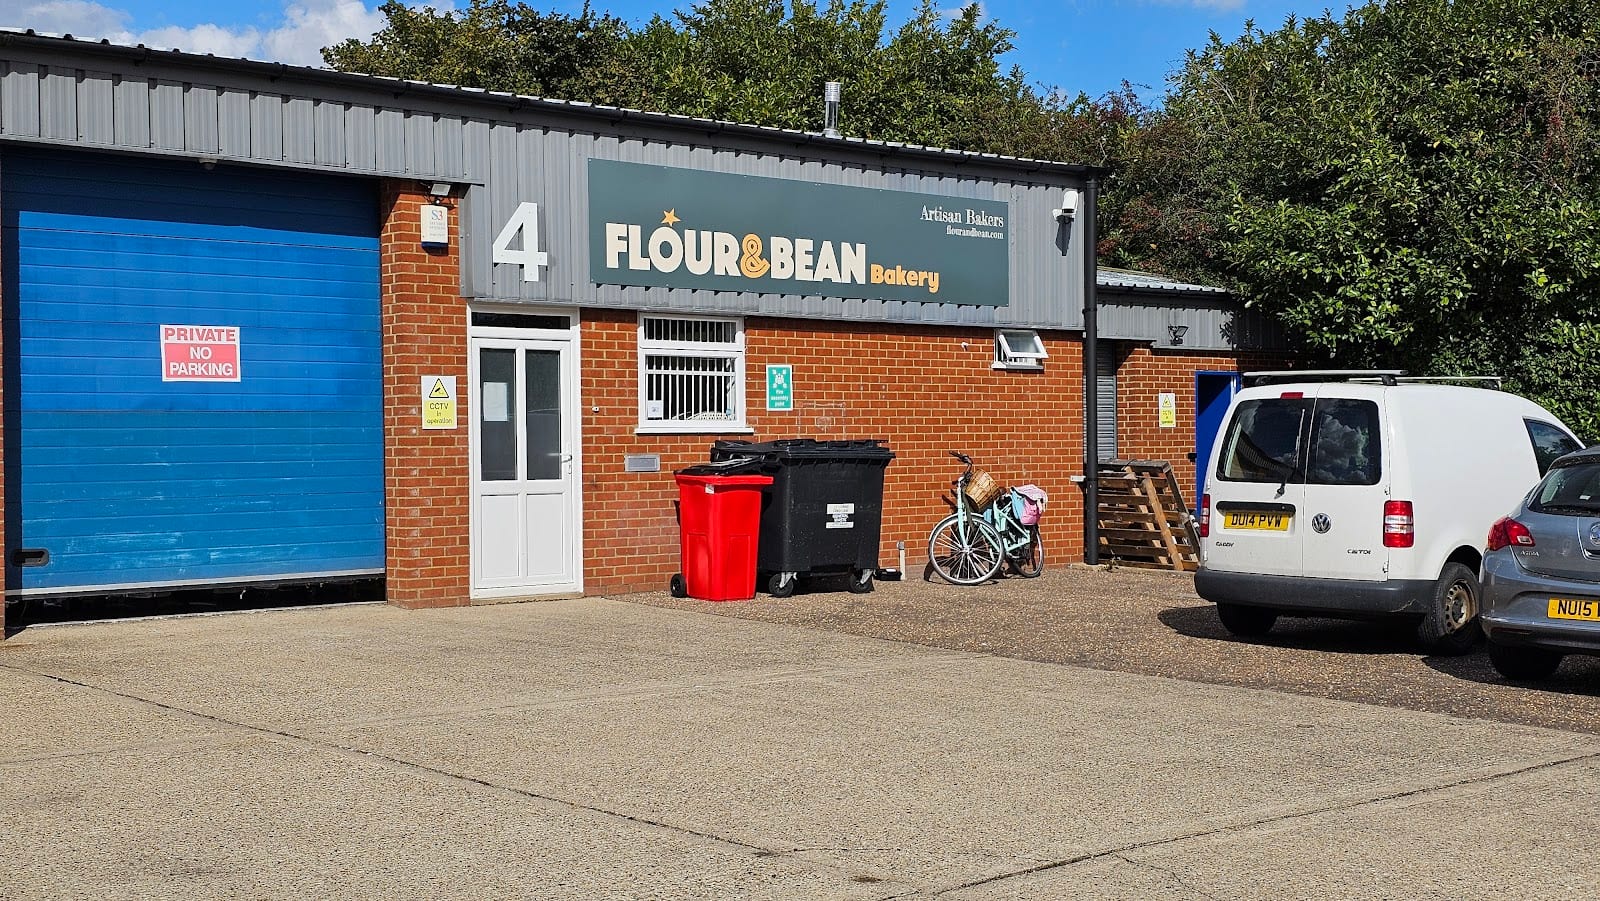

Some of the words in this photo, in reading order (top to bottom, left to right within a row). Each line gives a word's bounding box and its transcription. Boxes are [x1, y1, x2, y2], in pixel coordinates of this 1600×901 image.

[920, 204, 962, 224] Artisan
[966, 209, 1004, 228] Bakers
[492, 202, 548, 281] 4
[870, 263, 940, 294] Bakery
[164, 327, 236, 342] PRIVATE
[189, 346, 212, 360] NO
[169, 361, 233, 376] PARKING
[429, 402, 449, 410] CCTV
[1231, 513, 1256, 526] DU14
[1258, 515, 1282, 527] PVW
[1557, 600, 1593, 617] NU15
